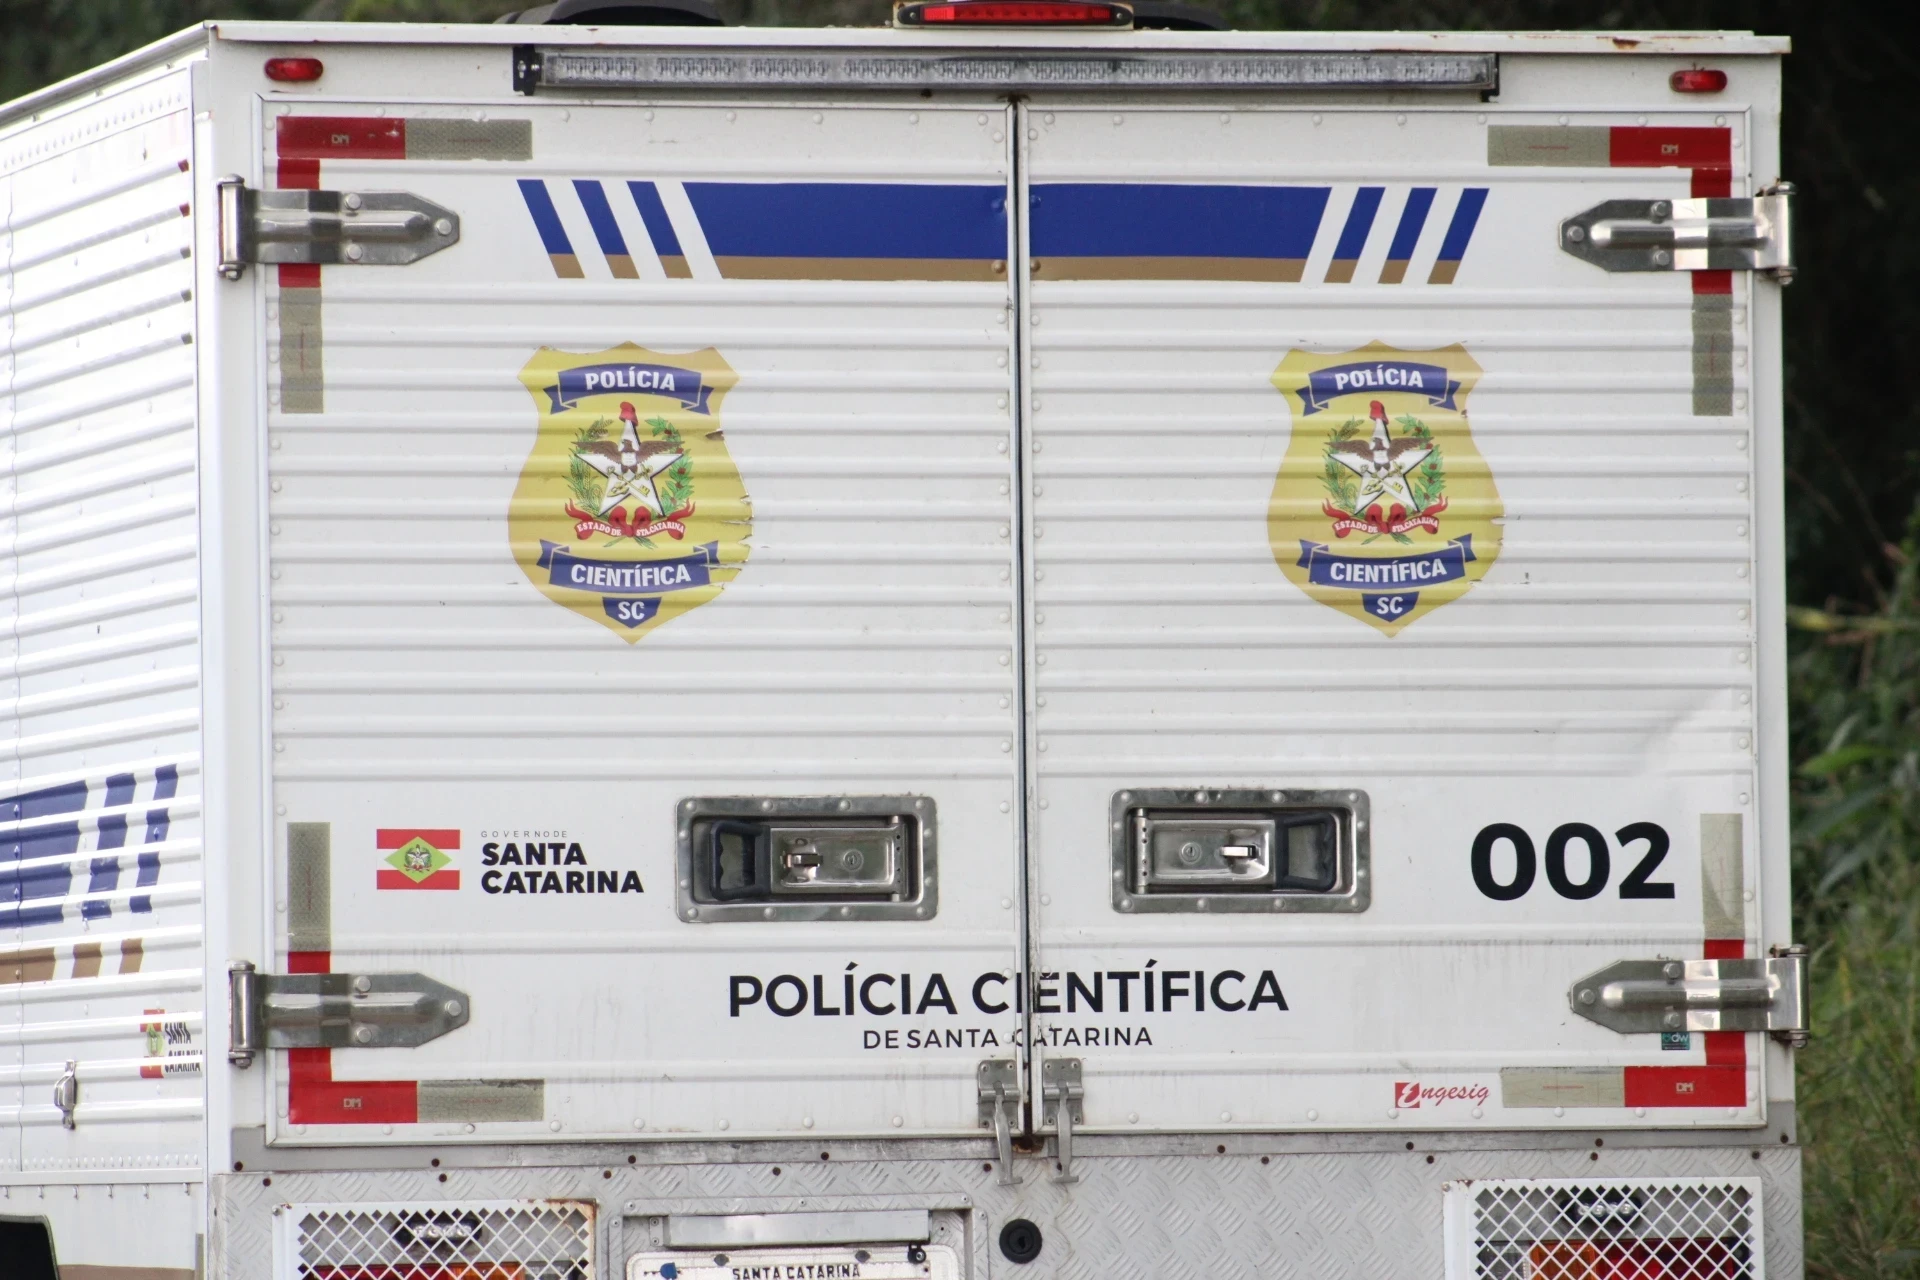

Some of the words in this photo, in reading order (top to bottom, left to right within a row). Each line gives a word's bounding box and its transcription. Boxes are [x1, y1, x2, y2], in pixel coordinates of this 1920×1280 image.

[585, 367, 675, 391] POLÍCIA
[1335, 365, 1423, 390] POLÍCIA
[577, 522, 611, 534] ESTADO
[1335, 520, 1367, 531] ESTADO
[1368, 525, 1378, 533] DE
[571, 563, 691, 588] CIENTÍFICA
[1330, 558, 1447, 584] CIENTÍFICA
[618, 601, 645, 620] SC
[1376, 596, 1403, 614] SC
[482, 842, 588, 866] SANTA
[1471, 822, 1675, 901] 002
[481, 870, 645, 894] CATARINA
[729, 962, 958, 1017] POLÍCIA
[972, 959, 1289, 1015] CIENTÍFICA
[165, 1022, 191, 1045] SANTA
[864, 1030, 899, 1049] DE
[906, 1029, 999, 1048] SANTA
[1395, 1083, 1489, 1108] Engesig
[732, 1267, 781, 1279] SANTA
[786, 1264, 861, 1279] CATARINA
